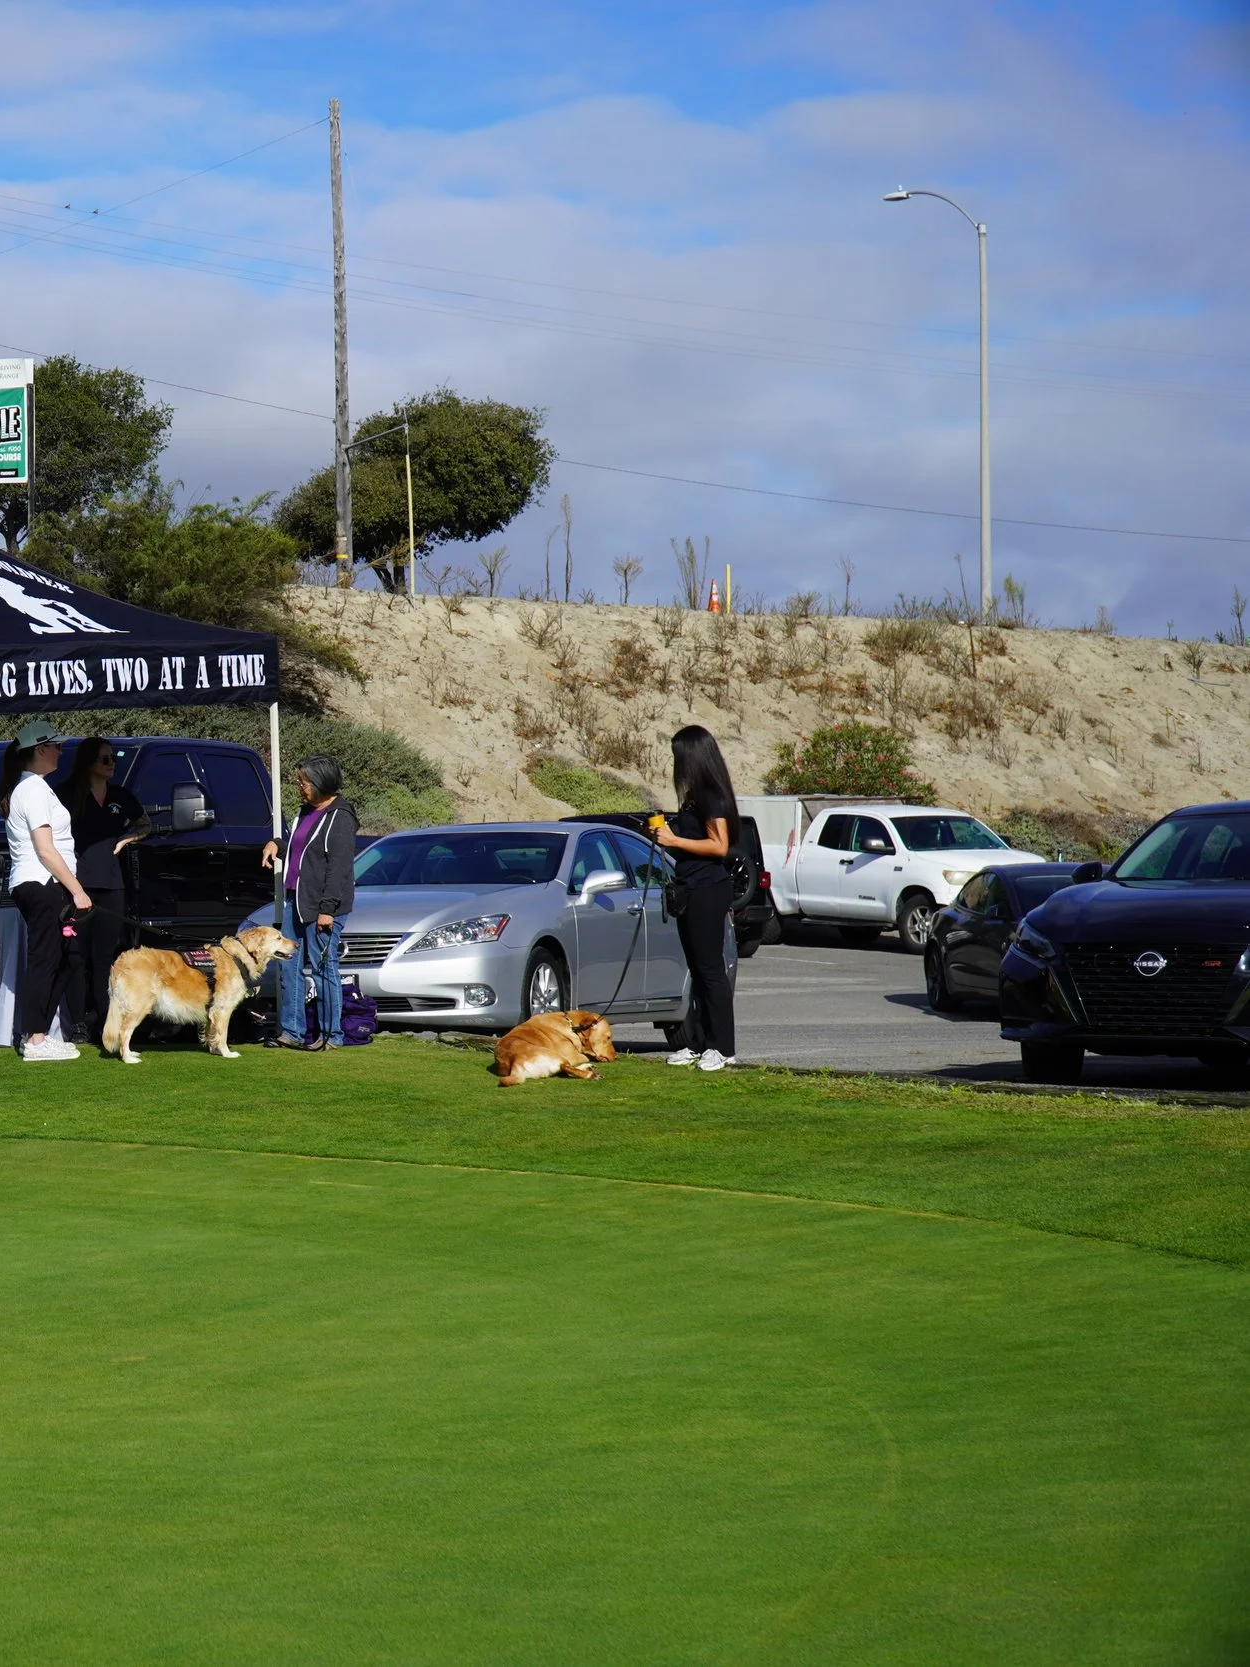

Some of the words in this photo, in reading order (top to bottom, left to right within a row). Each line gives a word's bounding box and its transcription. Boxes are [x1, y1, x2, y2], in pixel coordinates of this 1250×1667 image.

[26, 658, 94, 696] LIVES,
[102, 657, 149, 692] TWO
[158, 656, 185, 690] AT
[195, 656, 210, 689] A
[218, 654, 265, 687] TIME
